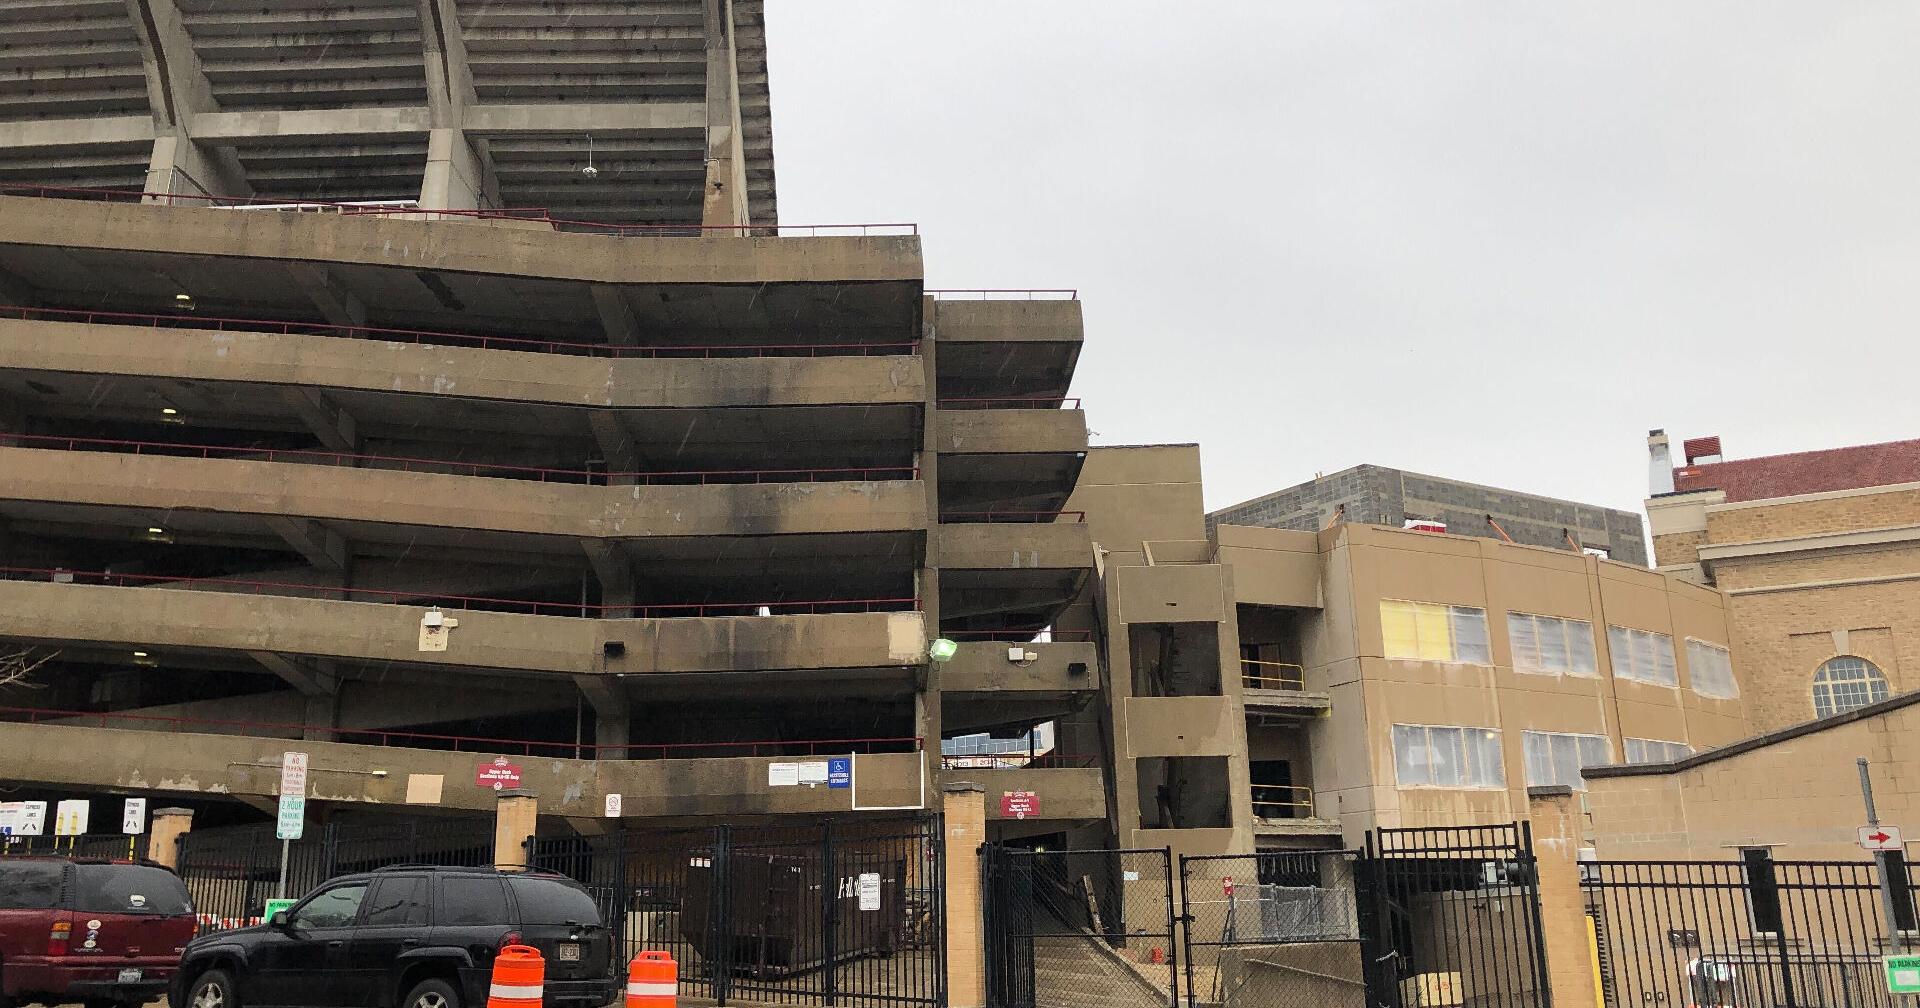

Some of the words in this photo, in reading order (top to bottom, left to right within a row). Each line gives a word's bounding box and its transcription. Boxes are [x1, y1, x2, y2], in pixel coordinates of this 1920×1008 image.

[281, 801, 286, 810] 2
[286, 801, 303, 810] HOUR
[1888, 960, 1897, 968] NO
